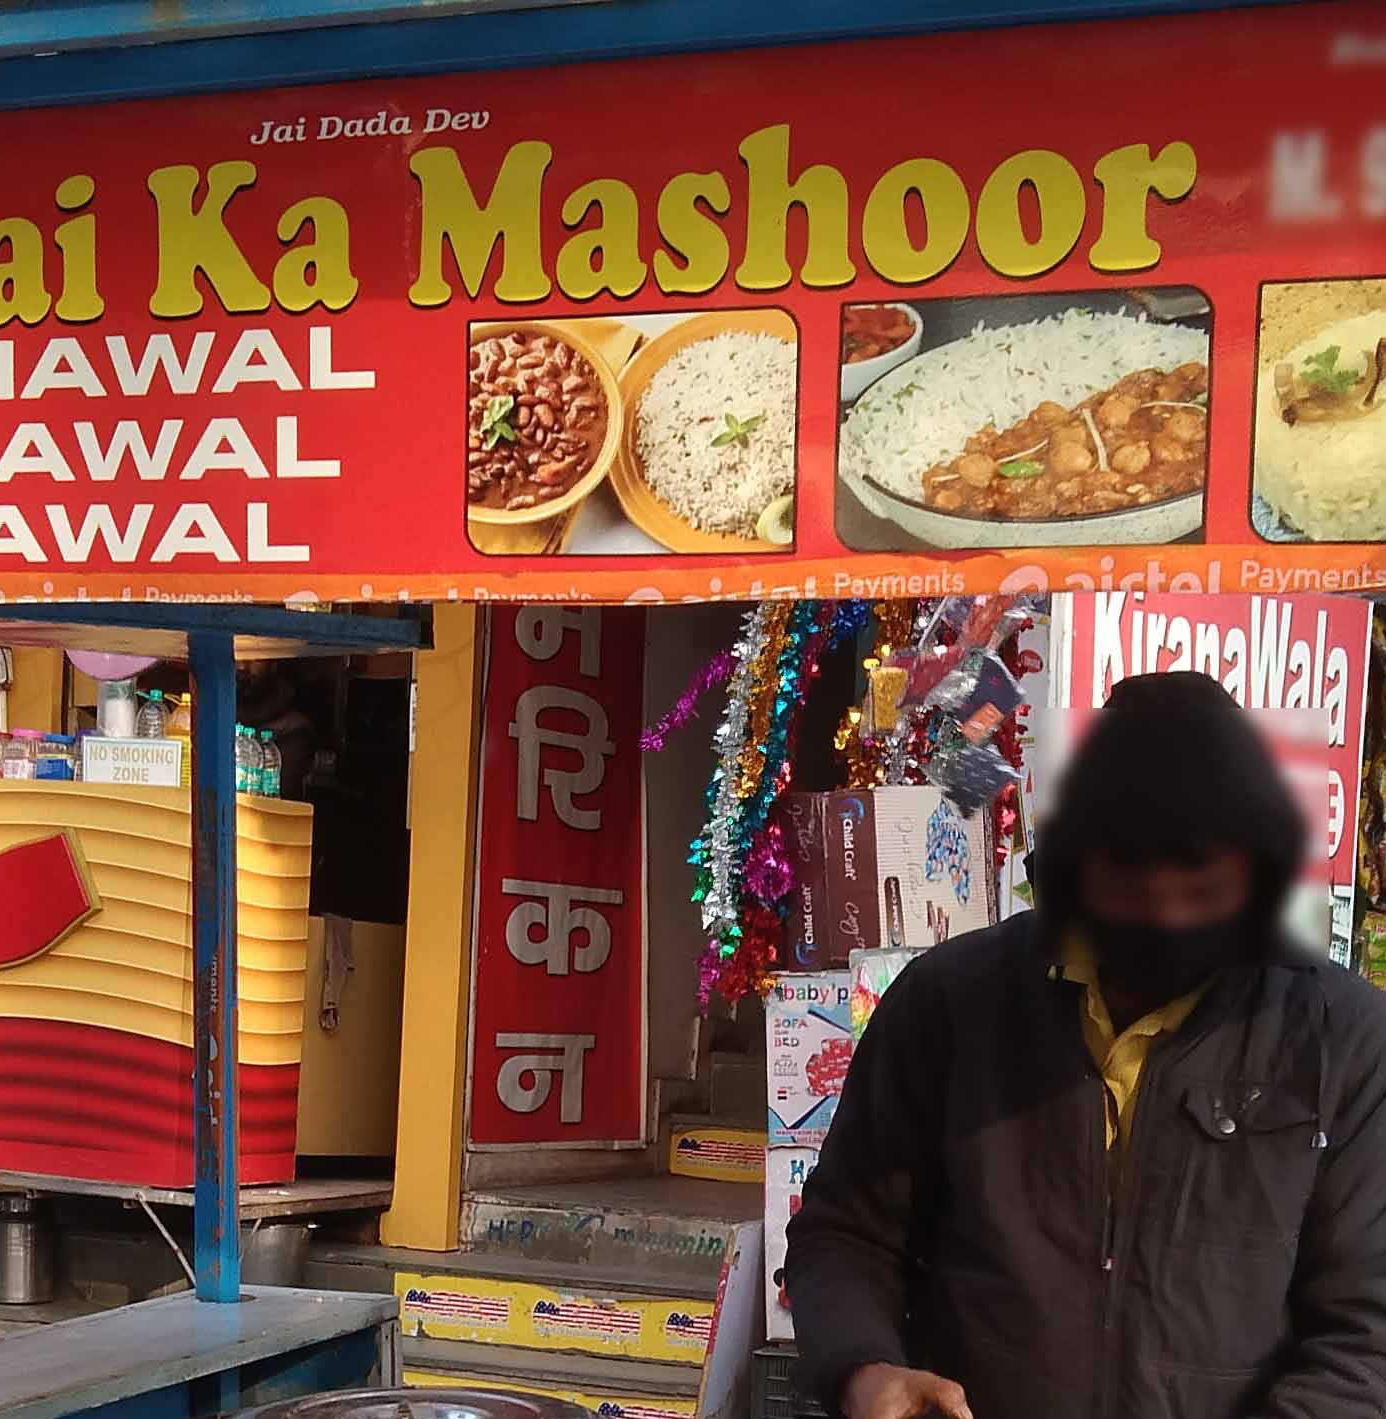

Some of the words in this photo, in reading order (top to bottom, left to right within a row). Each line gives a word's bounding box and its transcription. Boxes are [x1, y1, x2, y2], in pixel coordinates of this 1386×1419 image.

[251, 117, 306, 146] Jai
[317, 110, 412, 141] Dada
[424, 106, 491, 134] Dev
[147, 160, 359, 320] Ka
[408, 124, 1198, 309] Mashoor
[833, 569, 965, 597] Payments
[89, 746, 108, 763] NO
[112, 746, 175, 765] SMOKING
[112, 766, 150, 783] ZONE
[773, 1018, 809, 1029] SOFA
